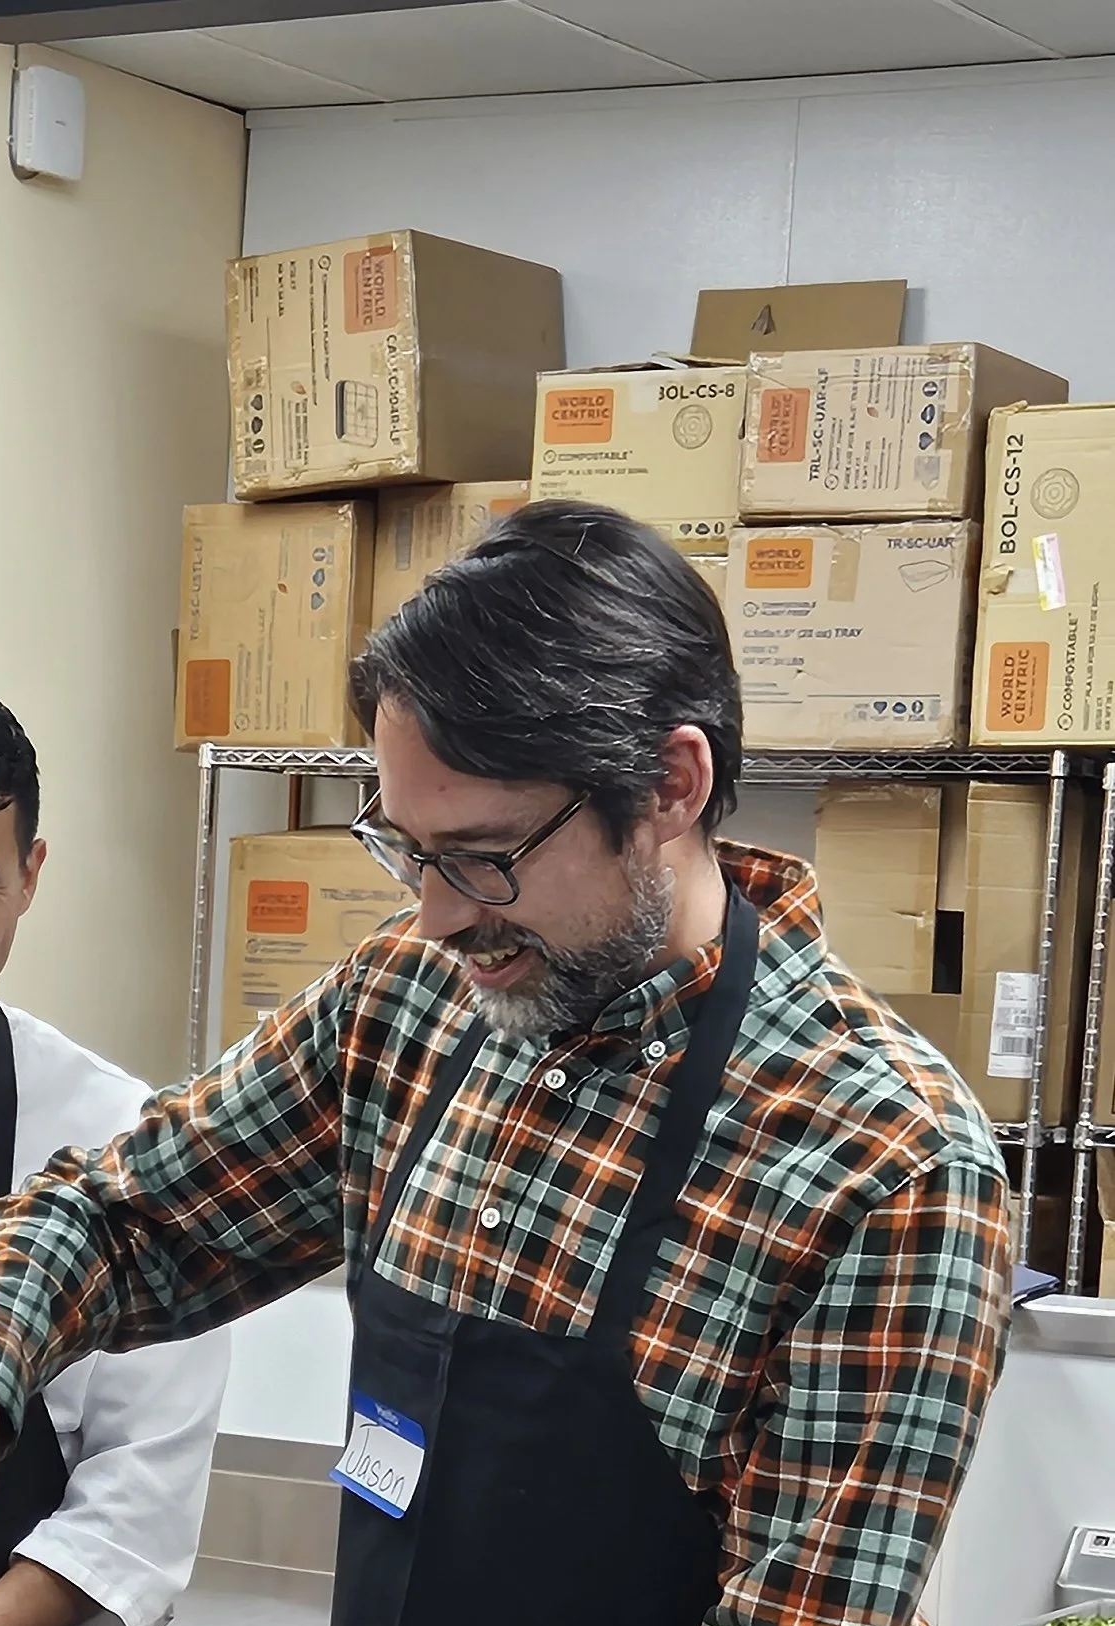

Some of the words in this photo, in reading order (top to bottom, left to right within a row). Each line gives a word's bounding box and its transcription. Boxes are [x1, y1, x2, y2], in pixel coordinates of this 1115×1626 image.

[374, 259, 386, 318] WORLD
[552, 408, 610, 421] CENTRIC
[557, 395, 605, 406] WORLD
[809, 368, 829, 482] TRL-SC-UAR-LF
[1000, 433, 1024, 554] BOL-CS-12
[749, 560, 806, 571] CENTRIC
[756, 548, 801, 560] WORLD
[1001, 655, 1016, 719] WORLD
[1013, 649, 1031, 724] CENTRIC
[345, 1423, 405, 1505] Jason
